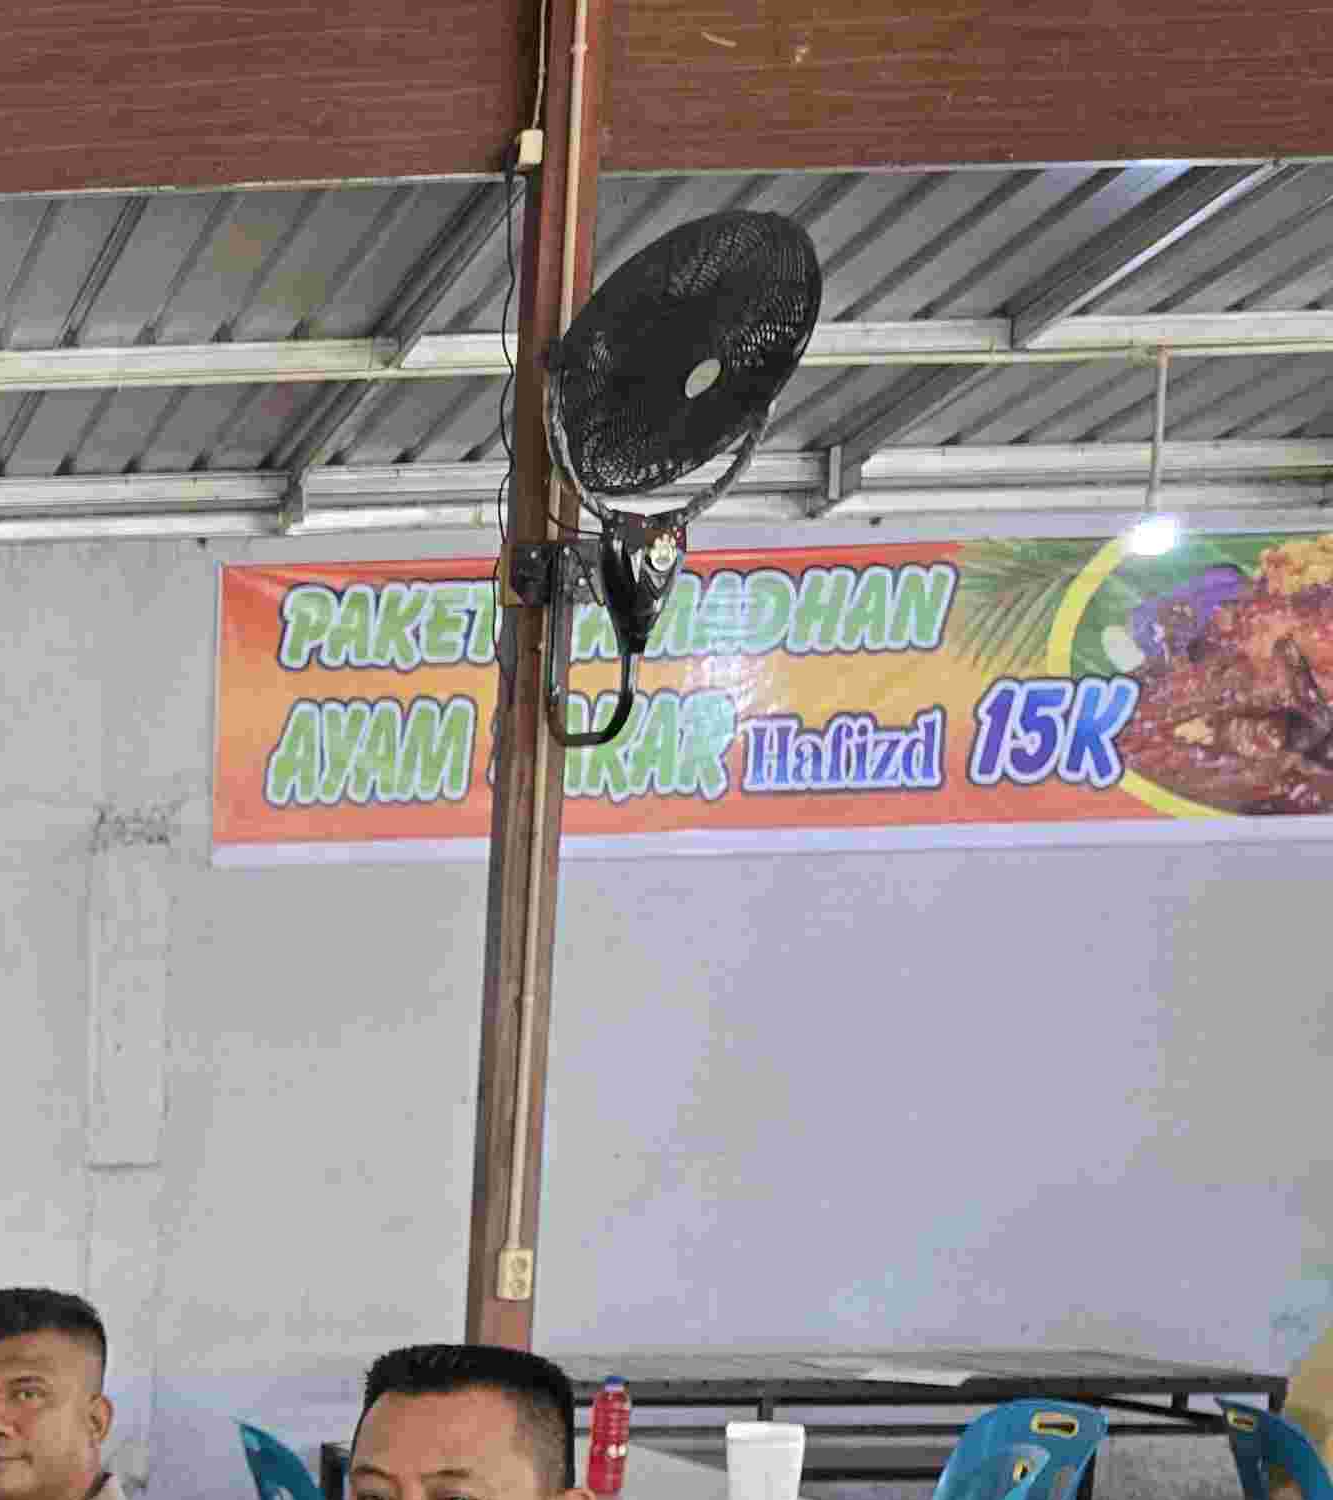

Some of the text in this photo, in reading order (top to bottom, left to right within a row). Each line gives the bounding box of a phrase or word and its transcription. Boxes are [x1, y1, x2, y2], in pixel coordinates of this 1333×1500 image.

[279, 580, 497, 672] PAKET
[266, 698, 476, 807] AYAM
[741, 703, 945, 790] Hafizd
[966, 676, 1140, 788] 15K
